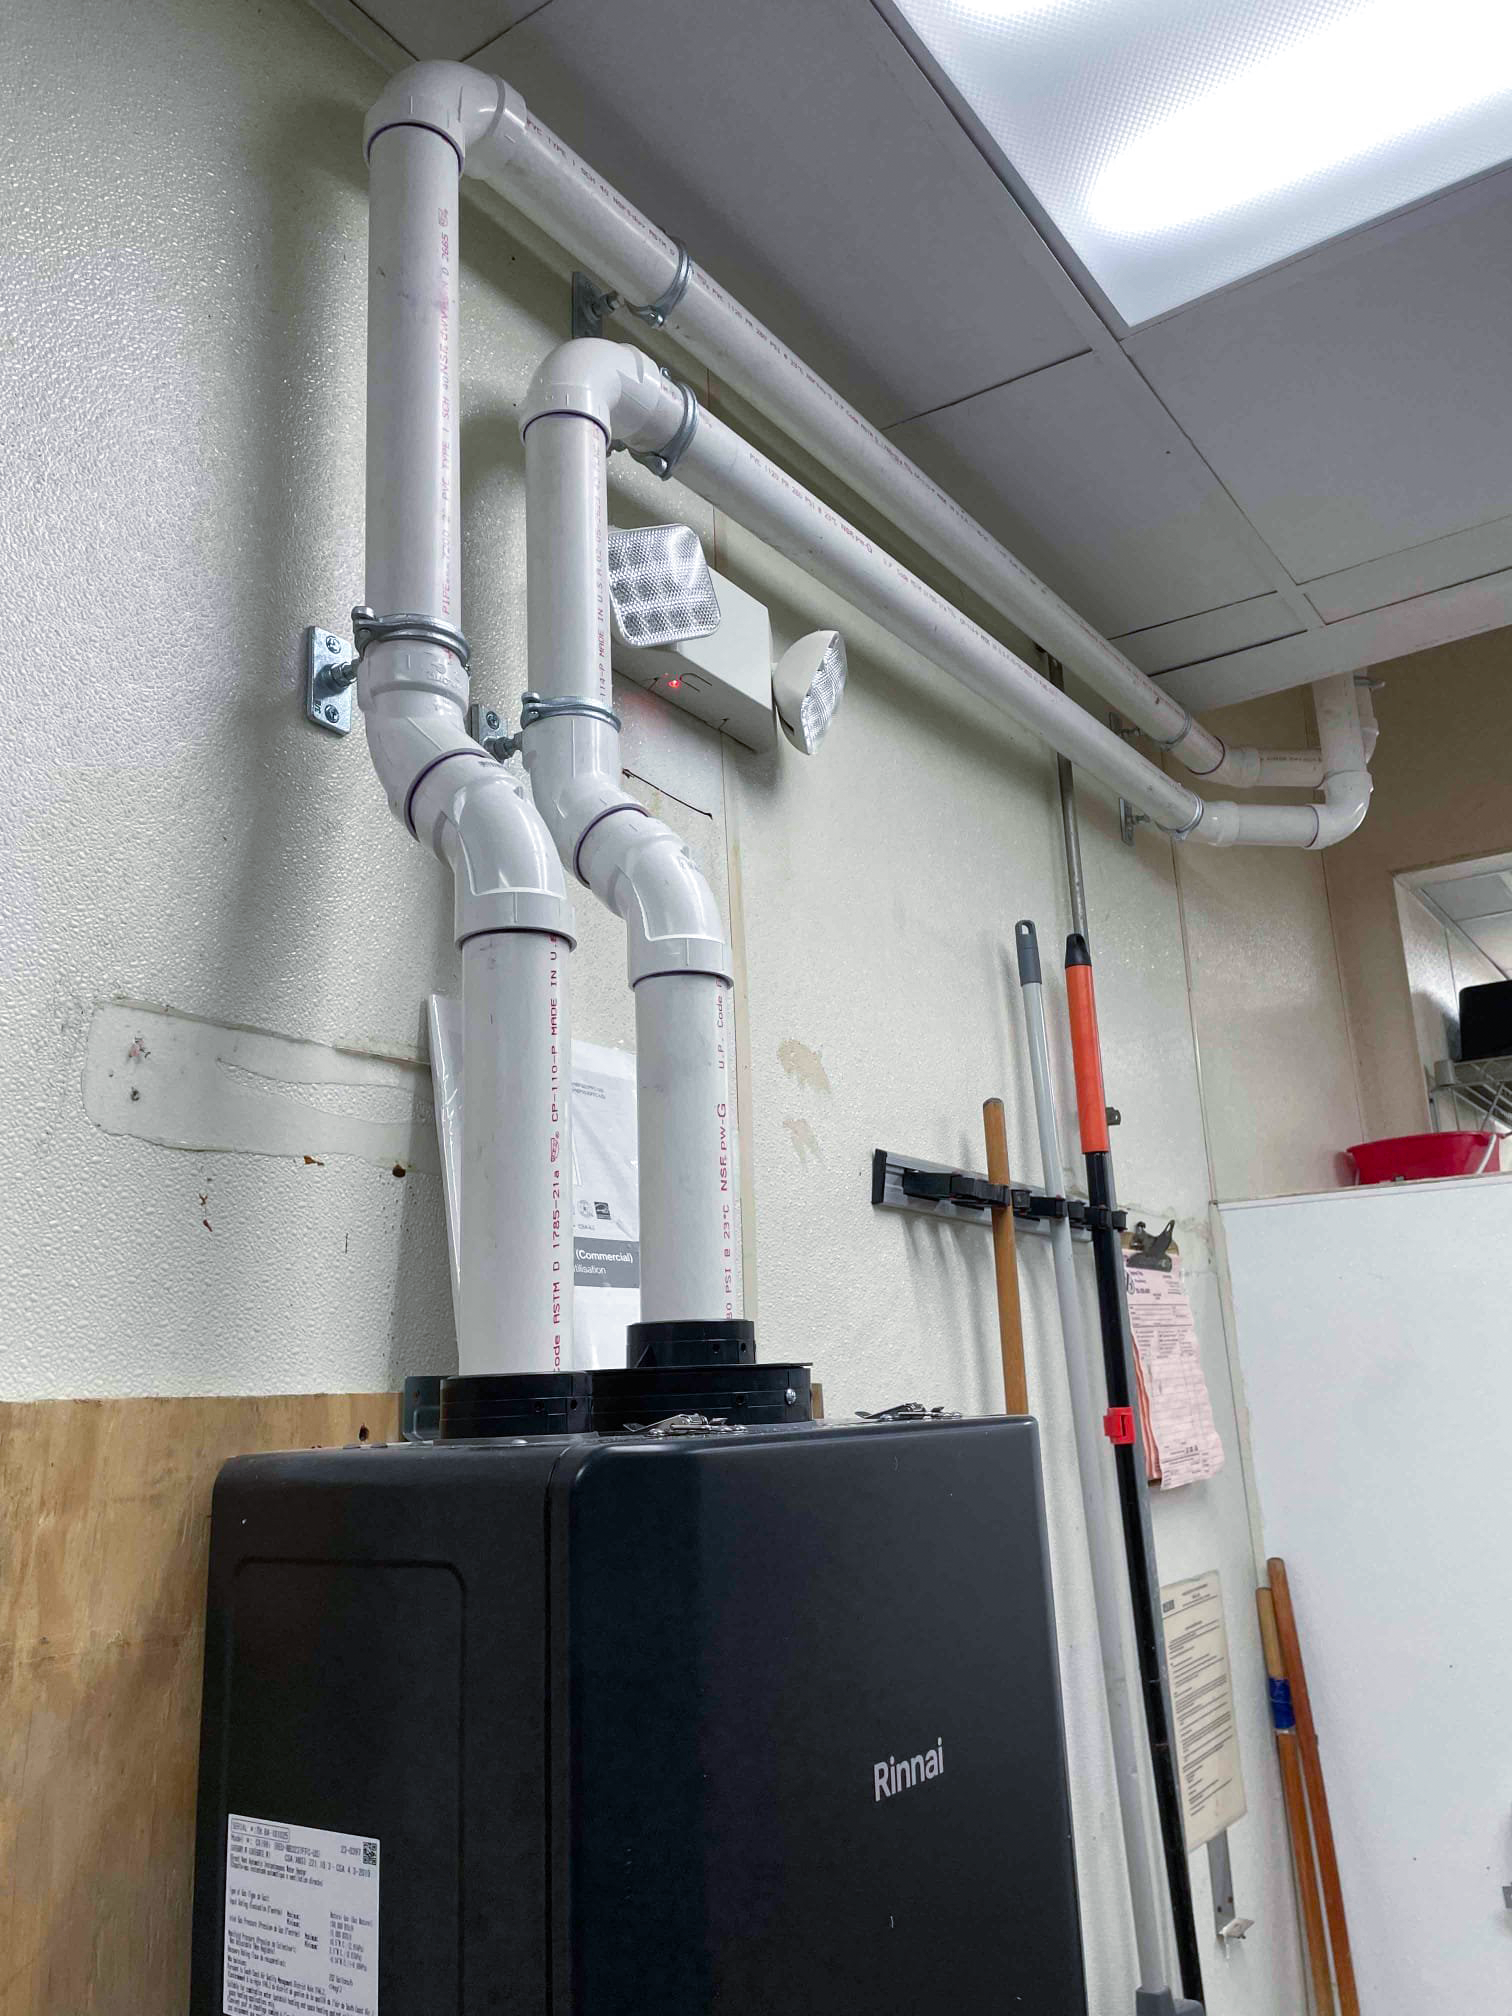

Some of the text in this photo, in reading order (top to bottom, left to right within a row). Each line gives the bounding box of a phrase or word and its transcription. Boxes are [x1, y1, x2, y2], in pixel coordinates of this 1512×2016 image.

[598, 608, 604, 622] IN
[550, 970, 558, 987] IN
[552, 1170, 560, 1249] 1785-21a
[576, 1248, 634, 1264] (Commercial)
[552, 1261, 560, 1272] D
[552, 1281, 560, 1324] ASTM
[874, 1736, 944, 1802] Rinnai
